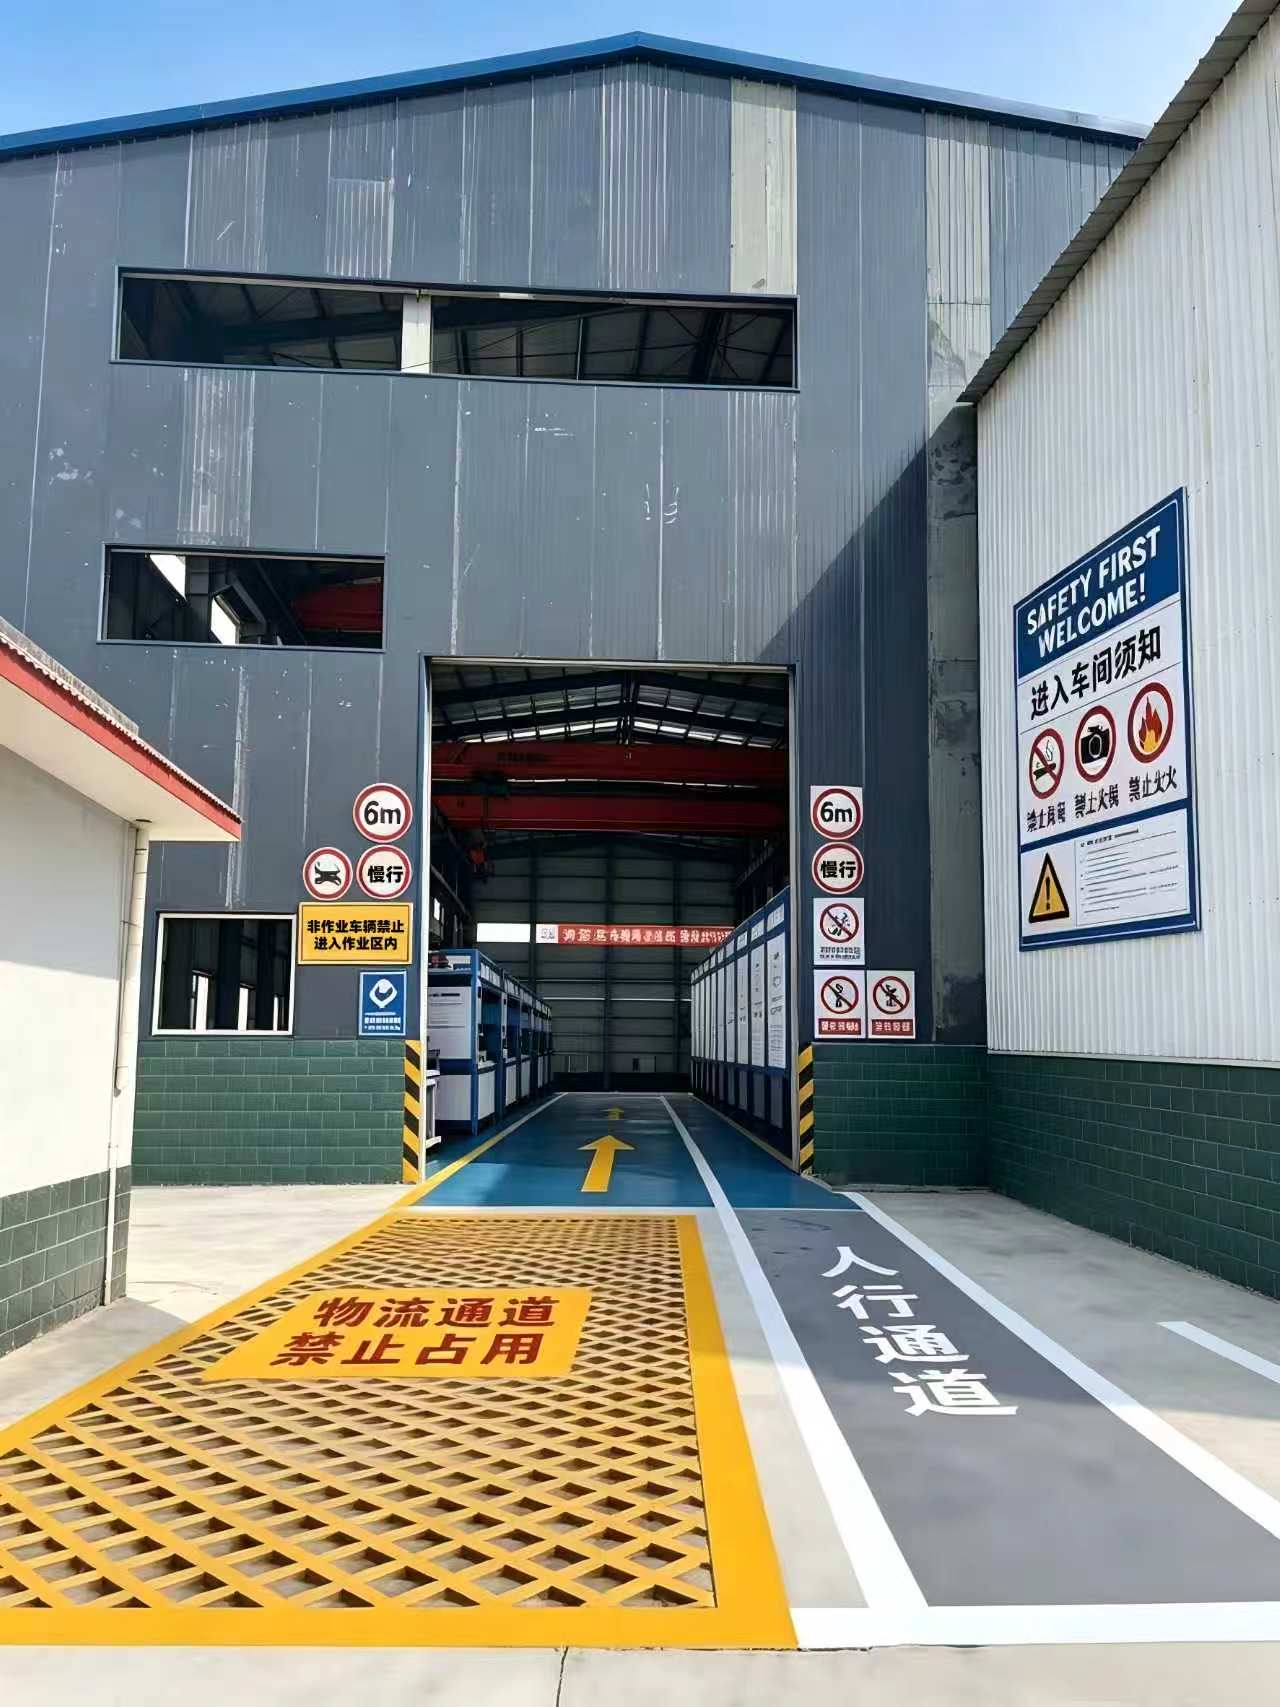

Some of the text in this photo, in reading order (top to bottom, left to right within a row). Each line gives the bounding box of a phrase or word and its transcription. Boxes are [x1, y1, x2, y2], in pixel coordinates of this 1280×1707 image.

[1027, 525, 1161, 635] SAFETY FIRST
[1038, 572, 1146, 658] WELCOME!
[1031, 626, 1161, 720] 进入车间须知
[364, 800, 402, 825] 6m
[820, 801, 853, 823] 6m
[367, 865, 404, 883] 慢行
[820, 860, 856, 879] 慢行
[307, 919, 405, 934] 非作业车辆禁止
[314, 936, 398, 950] 进入作业区内
[313, 1296, 560, 1328] 物流通道
[820, 1246, 1019, 1416] 人行通道
[269, 1332, 545, 1366] 禁止占用
